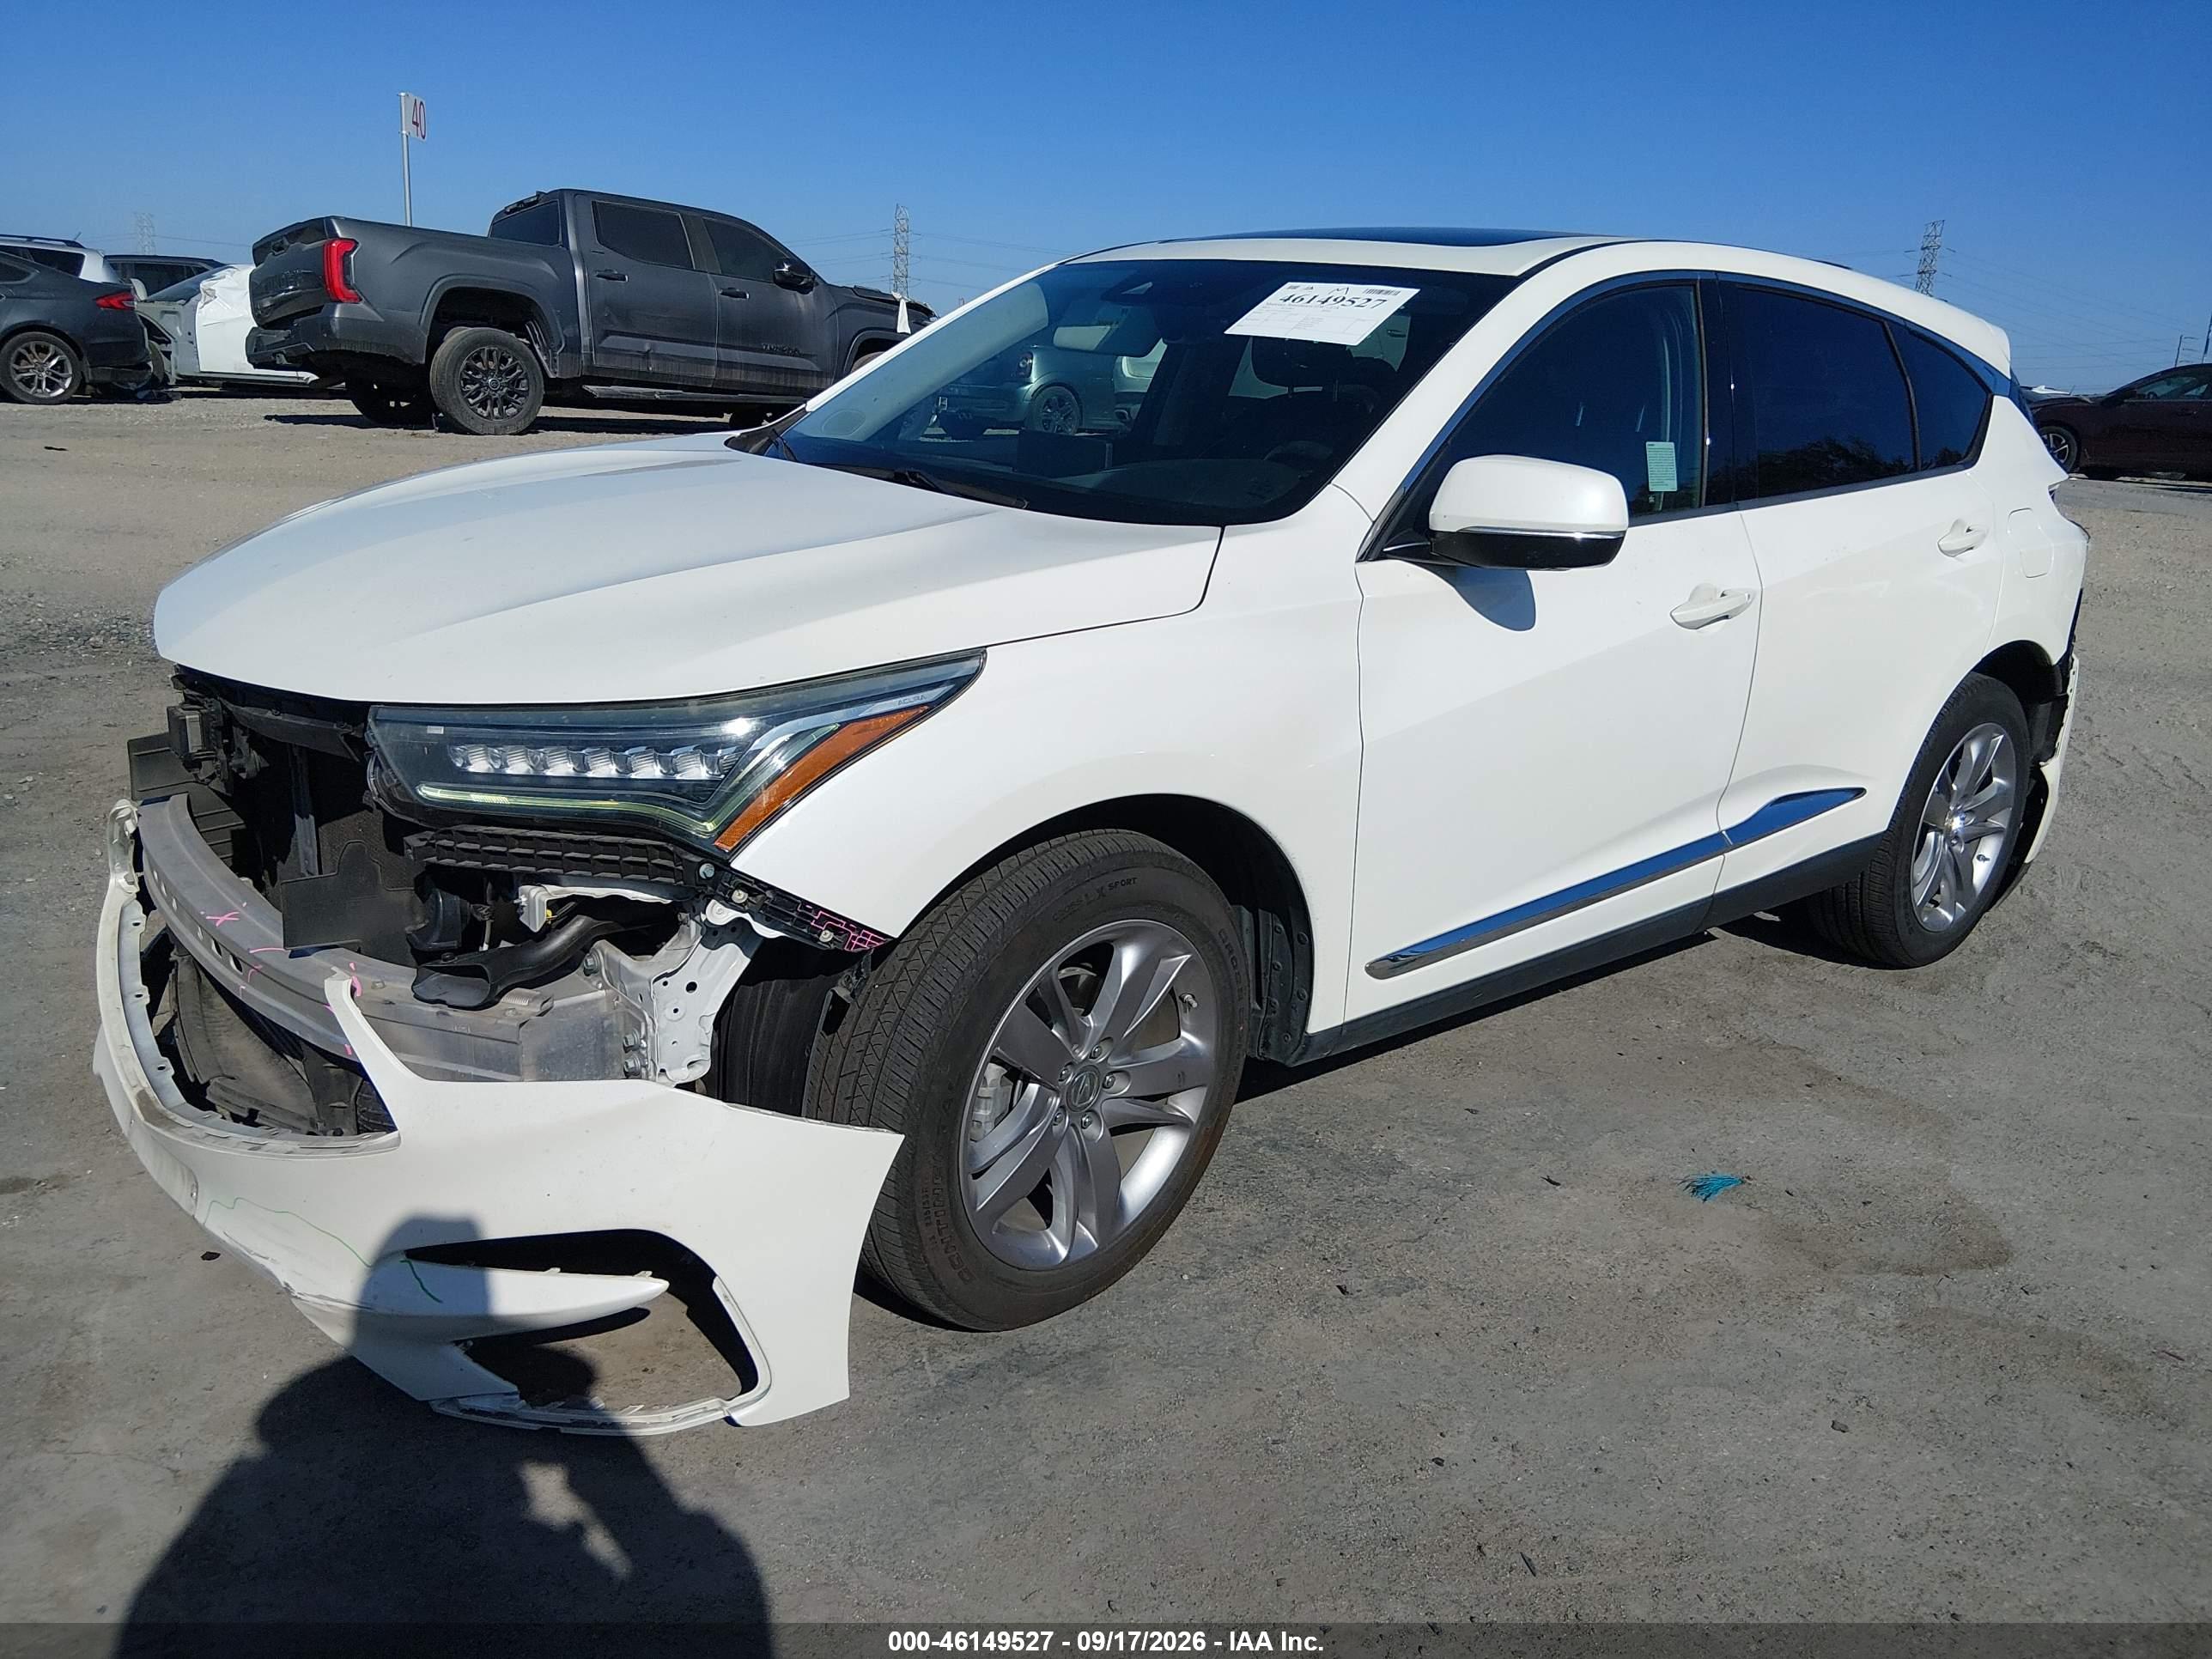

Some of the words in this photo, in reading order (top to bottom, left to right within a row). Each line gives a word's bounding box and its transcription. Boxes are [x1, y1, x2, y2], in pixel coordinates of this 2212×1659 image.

[412, 99, 426, 139] 40
[1279, 294, 1388, 309] 46149527
[1108, 877, 1138, 890] SPORT
